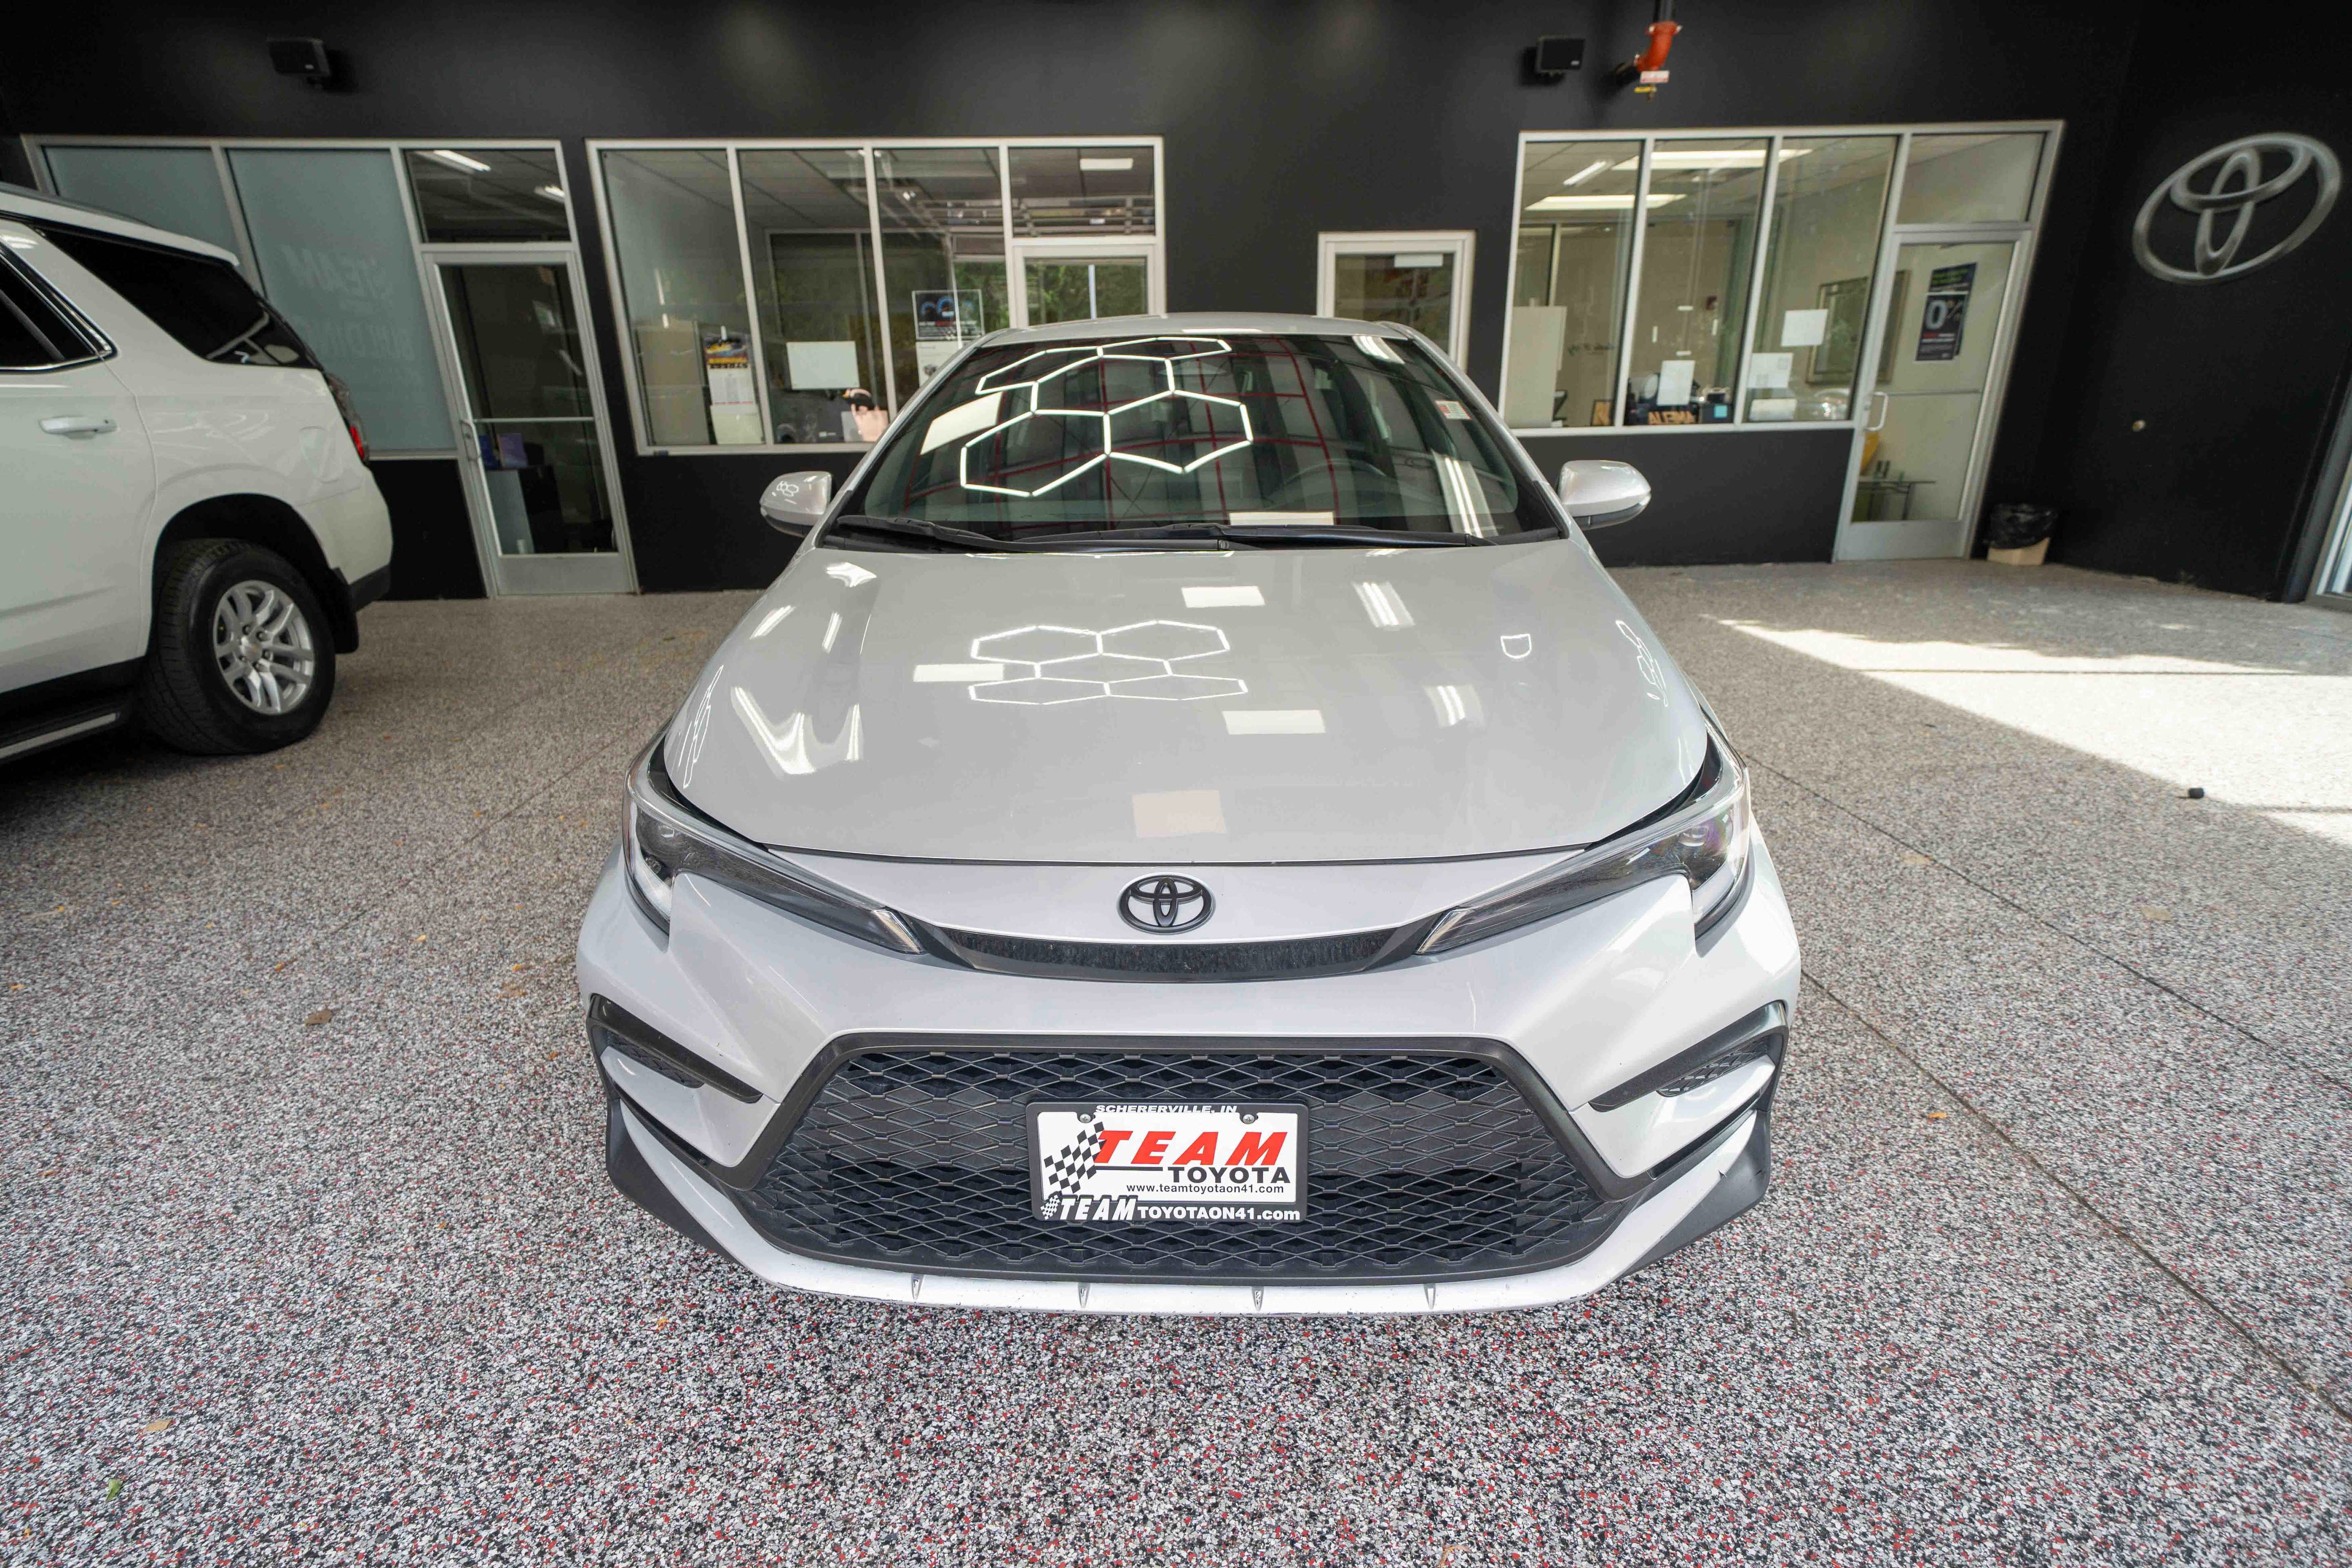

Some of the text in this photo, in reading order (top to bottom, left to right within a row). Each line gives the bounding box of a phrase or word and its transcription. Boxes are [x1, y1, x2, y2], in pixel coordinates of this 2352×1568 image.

[1095, 1105, 1238, 1114] SCHERERVILLE, IN
[1094, 1131, 1288, 1166] TEAM
[1167, 1167, 1291, 1183] TOYOTA
[1126, 1184, 1284, 1194] www.teamtoyotaon41.com
